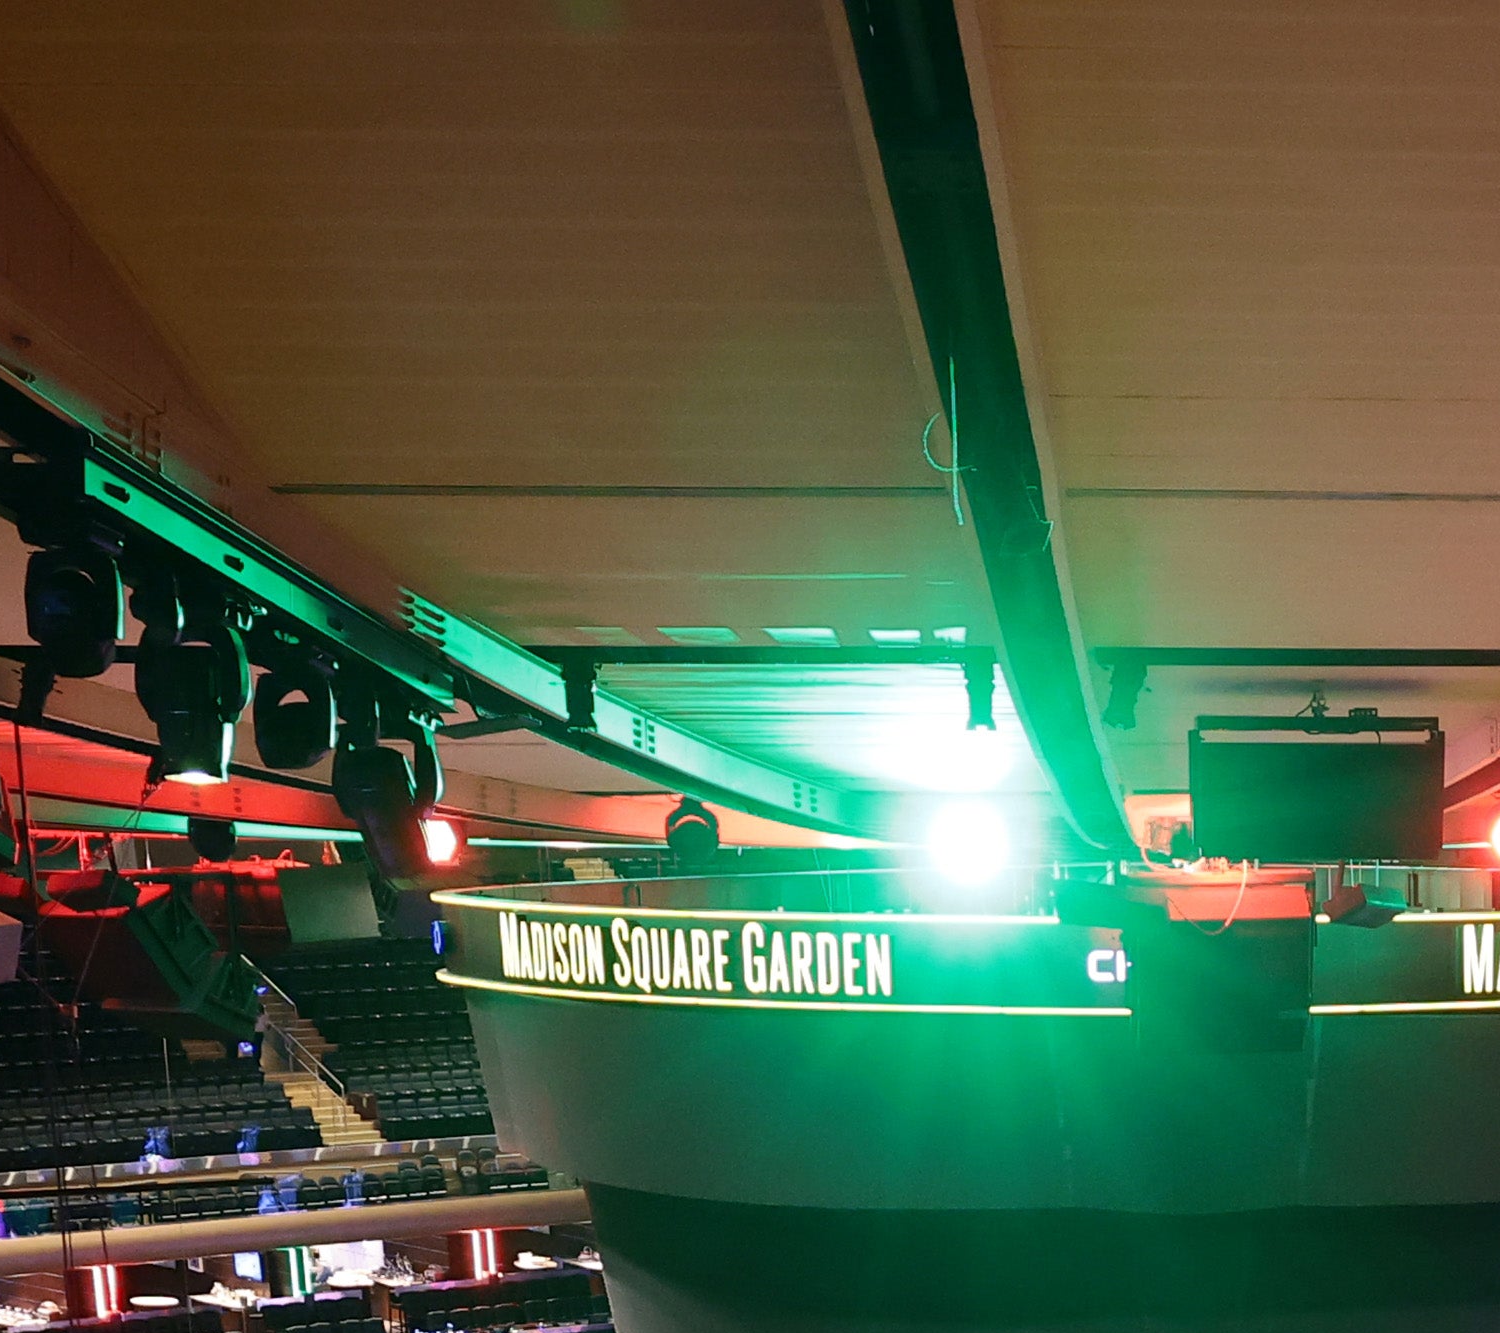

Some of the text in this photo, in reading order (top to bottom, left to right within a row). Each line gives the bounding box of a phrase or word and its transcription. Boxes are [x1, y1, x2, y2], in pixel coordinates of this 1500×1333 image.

[499, 911, 892, 996] MADISON SQUARE GARDEN
